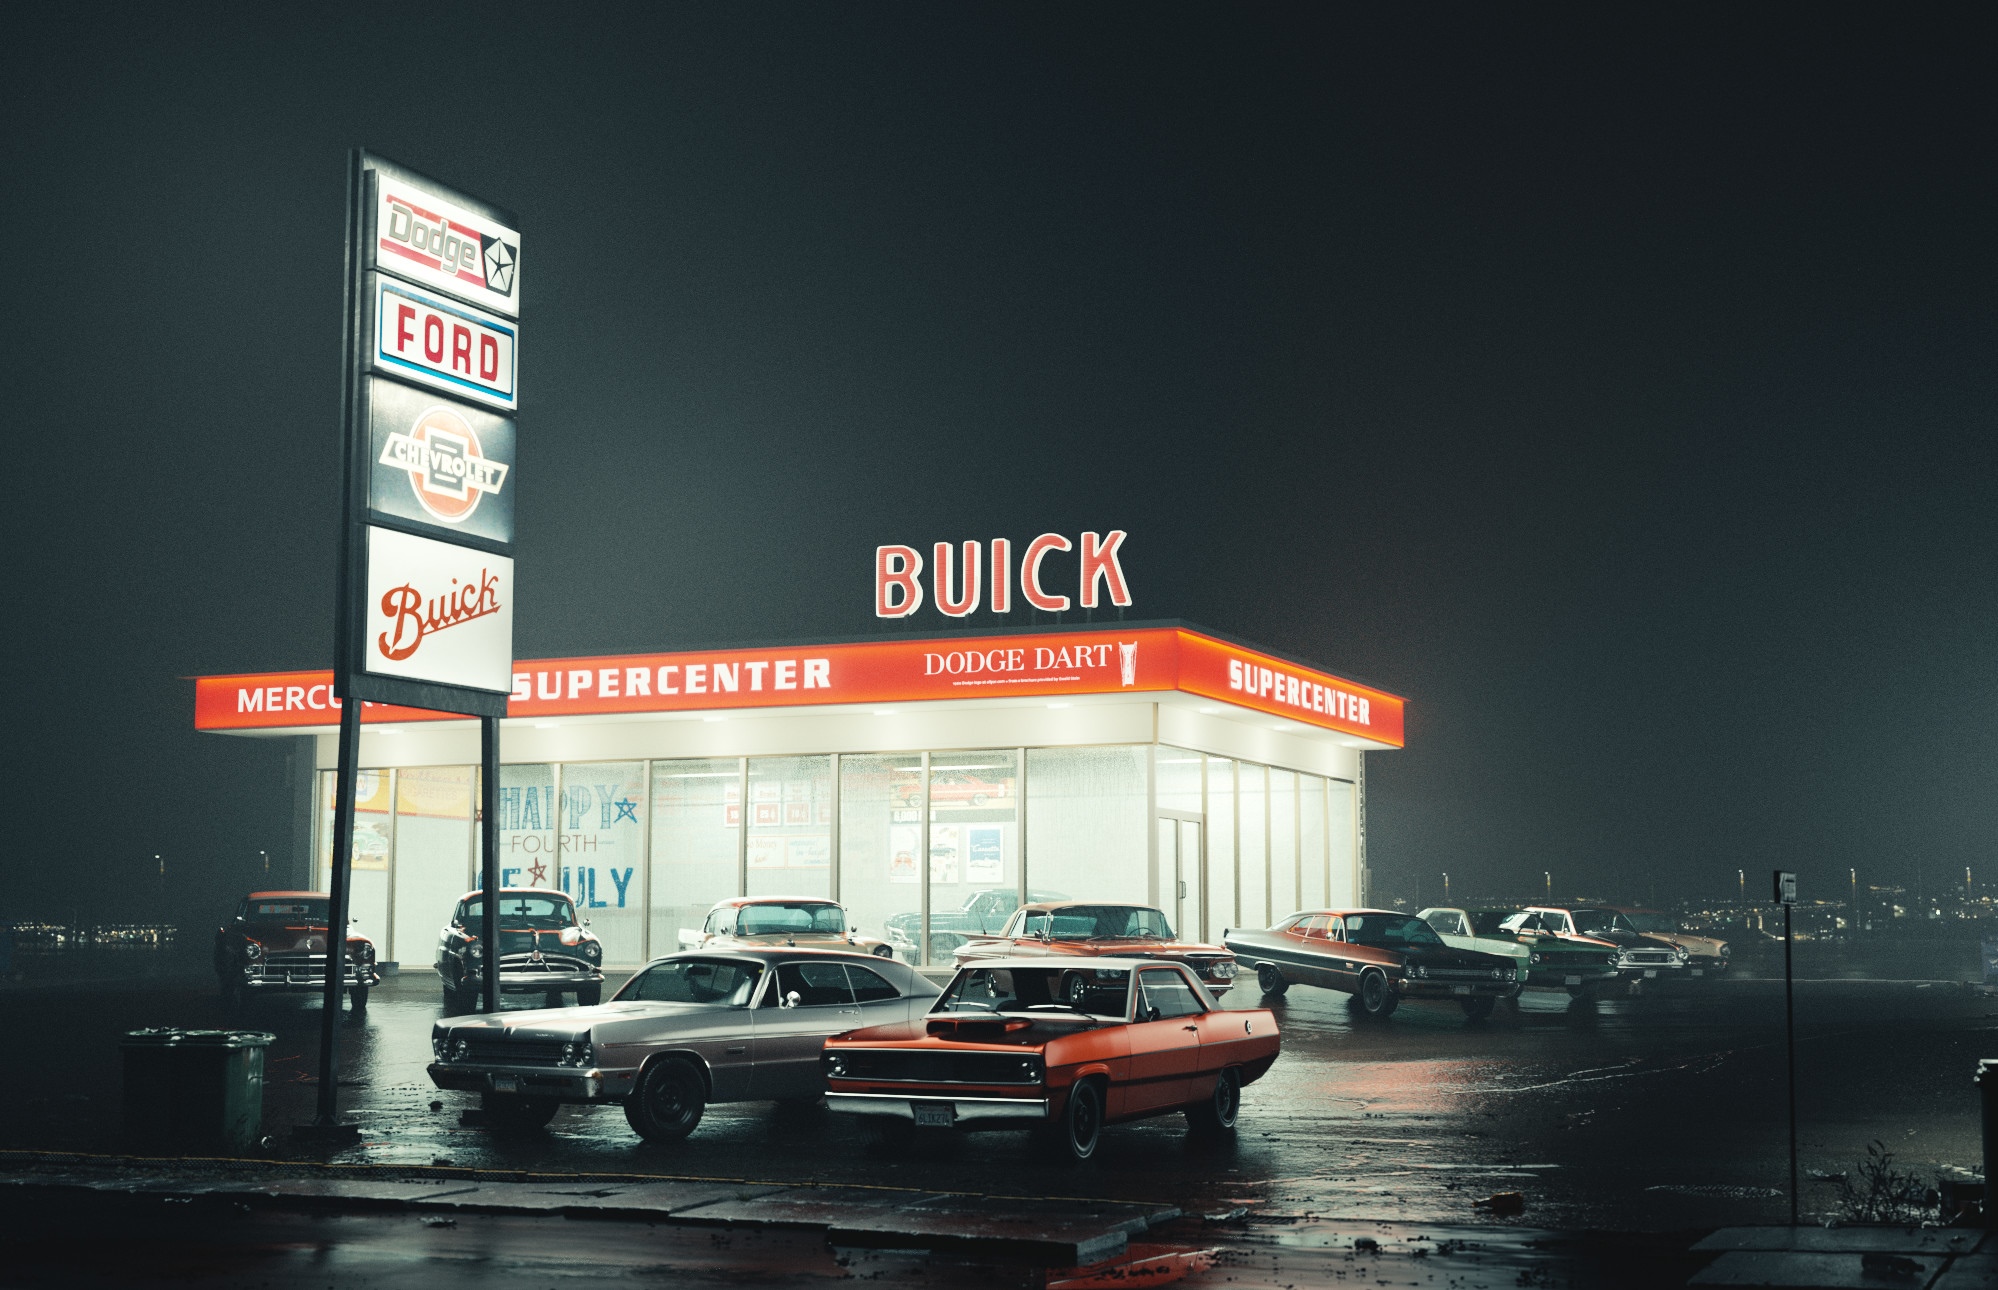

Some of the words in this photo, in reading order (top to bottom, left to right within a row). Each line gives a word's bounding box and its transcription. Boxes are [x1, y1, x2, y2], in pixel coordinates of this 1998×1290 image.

[388, 203, 476, 273] Dodge
[397, 303, 499, 382] FORD
[394, 440, 495, 485] CHEVROLET
[875, 530, 1133, 618] BUICK
[378, 567, 503, 661] Buick
[237, 684, 387, 713] MERCU
[508, 658, 832, 702] SUPERCENTER
[923, 648, 1025, 676] DODGE
[1033, 643, 1113, 670] DART
[1229, 659, 1371, 726] SUPERCENTER
[499, 785, 619, 831] HAPPY
[511, 833, 597, 853] FOURTH
